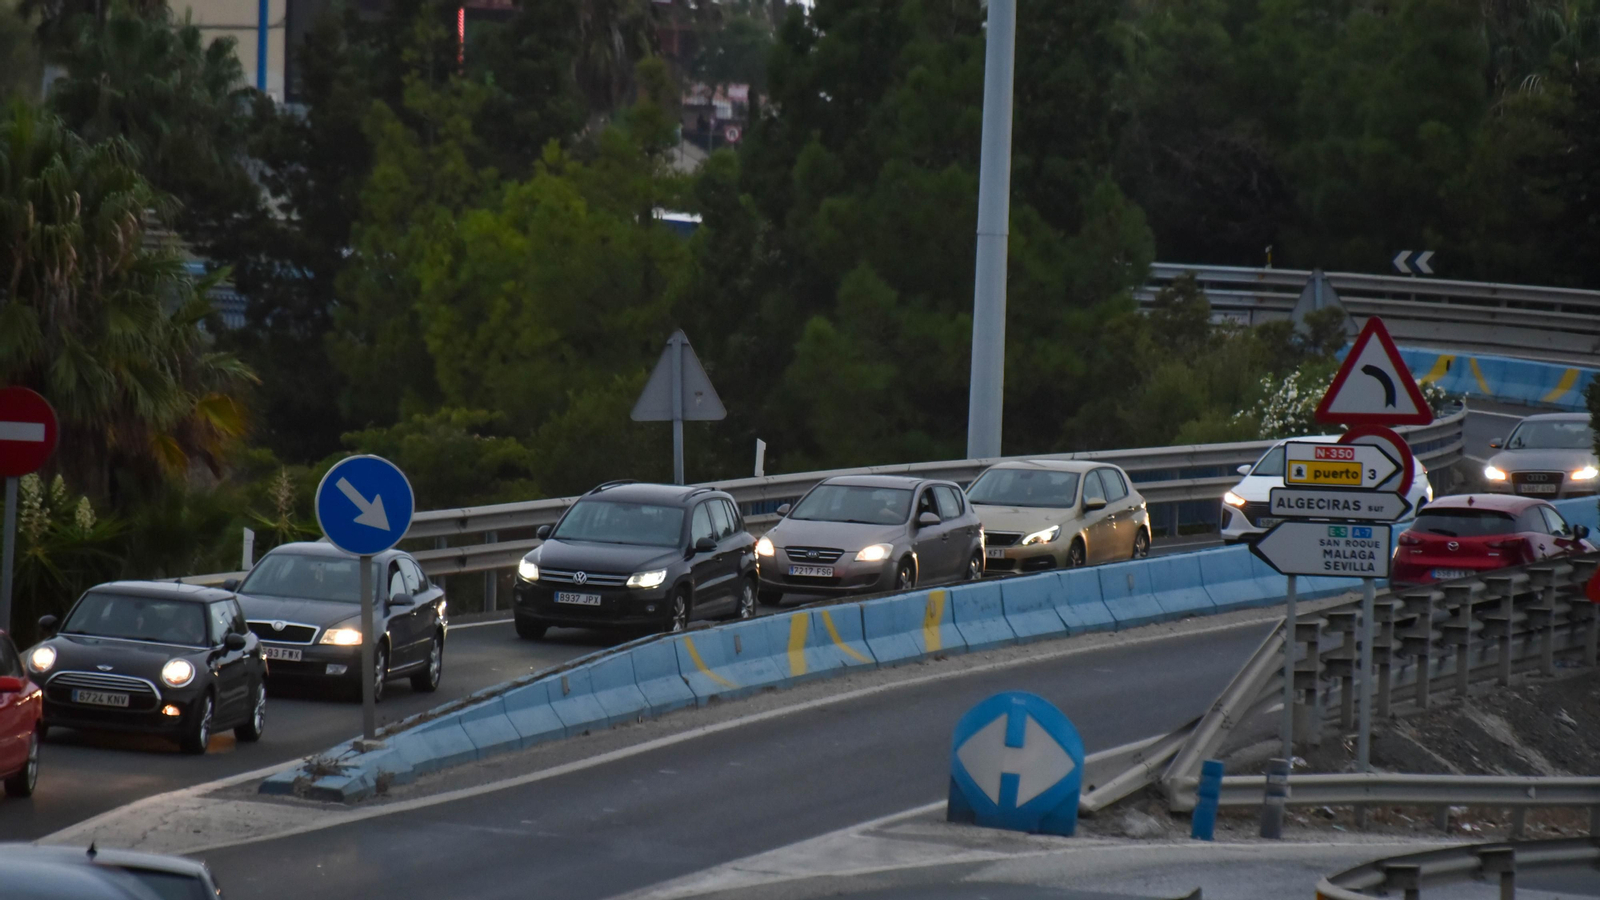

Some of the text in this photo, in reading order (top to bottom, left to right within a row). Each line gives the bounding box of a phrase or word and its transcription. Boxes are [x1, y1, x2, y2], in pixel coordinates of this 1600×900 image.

[1316, 448, 1354, 459] N-350
[1313, 468, 1359, 481] puerto
[1367, 468, 1377, 480] 3
[1276, 497, 1362, 511] ALGECIRAS
[1329, 526, 1371, 538] E-5 A-7
[1319, 539, 1380, 549] SAN ROQUE
[1323, 549, 1376, 560] MALAGA
[794, 566, 832, 576] 7217 FSG
[1324, 561, 1375, 572] SEVILLA
[560, 593, 599, 605] 8937 JPX
[281, 649, 301, 660] FWX
[79, 691, 127, 706] 6724 KNV
